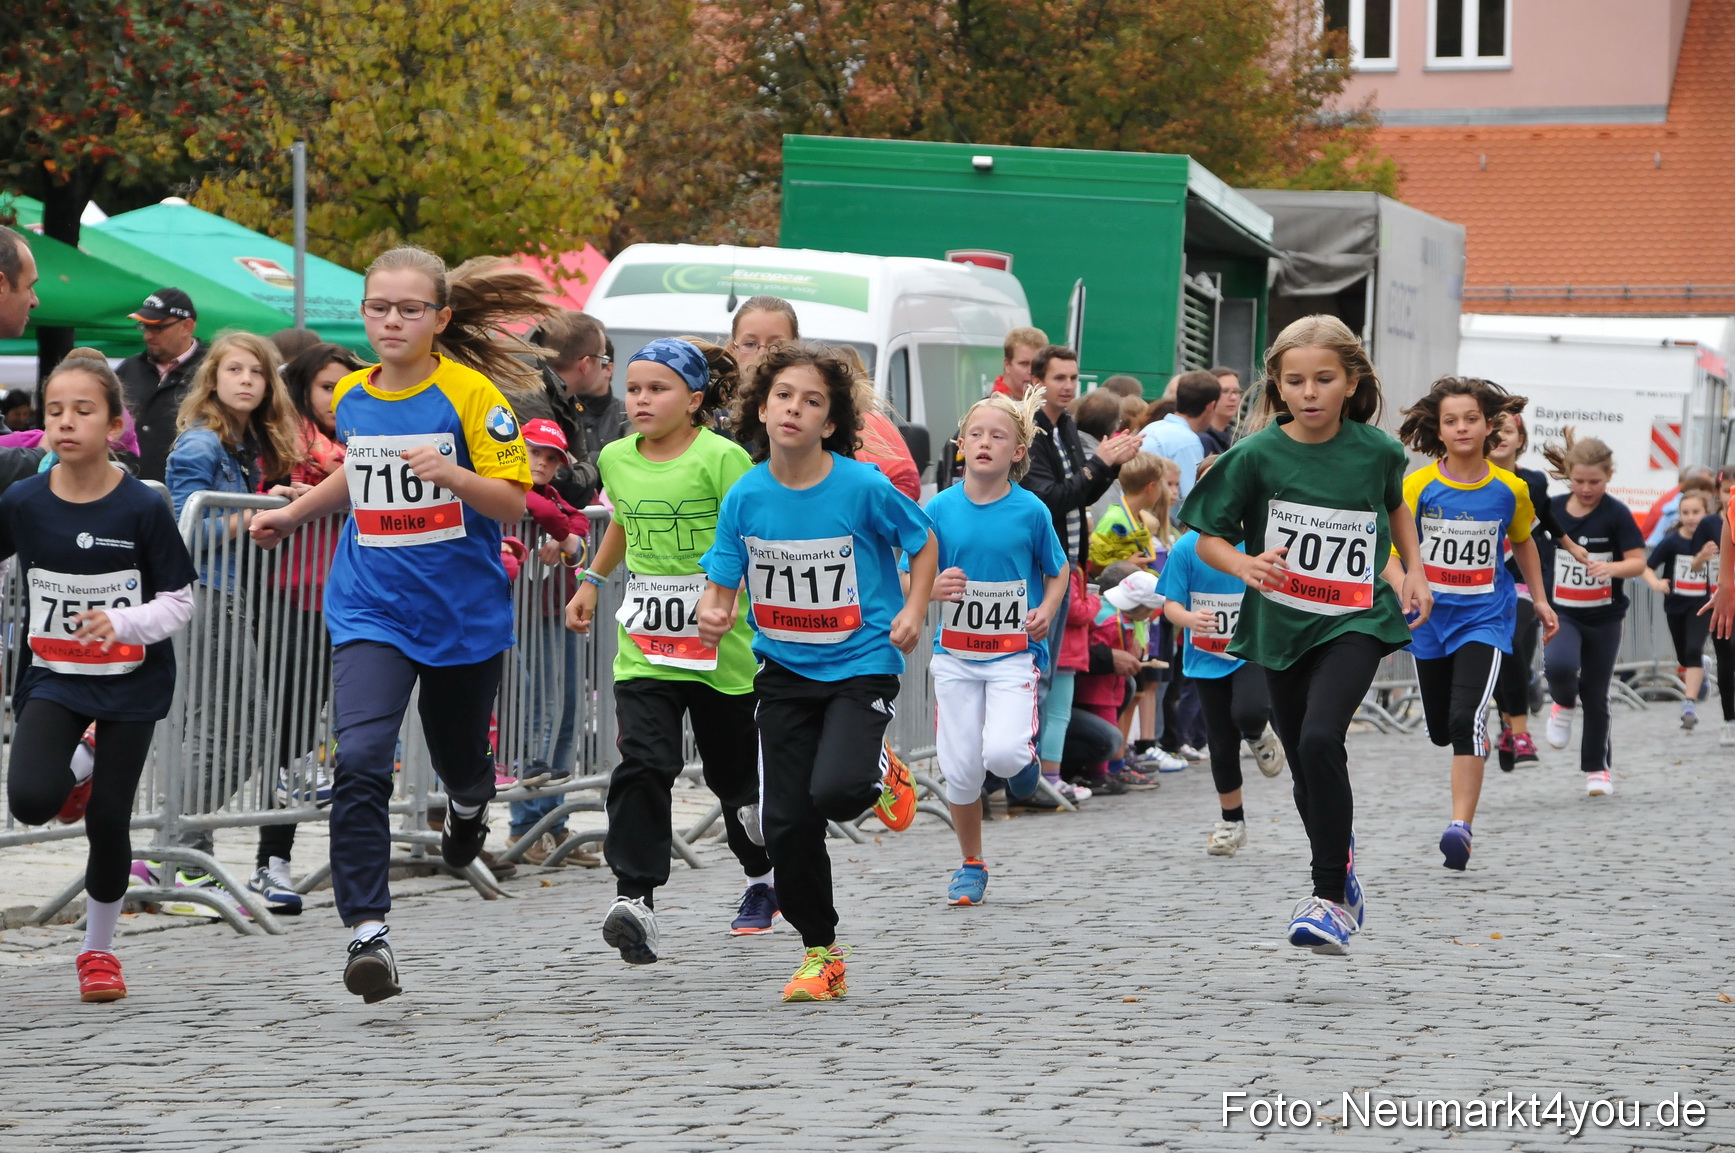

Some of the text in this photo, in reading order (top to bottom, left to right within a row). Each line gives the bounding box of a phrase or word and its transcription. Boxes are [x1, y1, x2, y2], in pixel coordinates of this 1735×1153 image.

[731, 268, 814, 282] Europcar
[716, 280, 817, 295] moving your way
[1535, 406, 1624, 423] Bayerisches
[347, 447, 378, 458] PARTL
[379, 515, 426, 531] Meike
[1270, 508, 1362, 532] PARTL Neumarkt
[1423, 524, 1487, 536] PARTL Neumarkt
[749, 546, 835, 561] PARTL Neumarkt
[1277, 526, 1368, 577] 7076
[1429, 535, 1491, 566] 7049
[1441, 571, 1472, 584] Stella
[1561, 563, 1604, 586] 755
[32, 578, 122, 595] PARTL Neumarkt
[628, 581, 700, 593] PARTL Neumarkt
[755, 563, 846, 604] 7117
[1290, 577, 1341, 604] Svenja
[972, 589, 1014, 598] Neumarkt
[1192, 598, 1216, 607] PARTL
[772, 610, 839, 629] Franziska
[950, 600, 1021, 630] 7044
[650, 639, 675, 654] Eva
[966, 636, 999, 650] Larah
